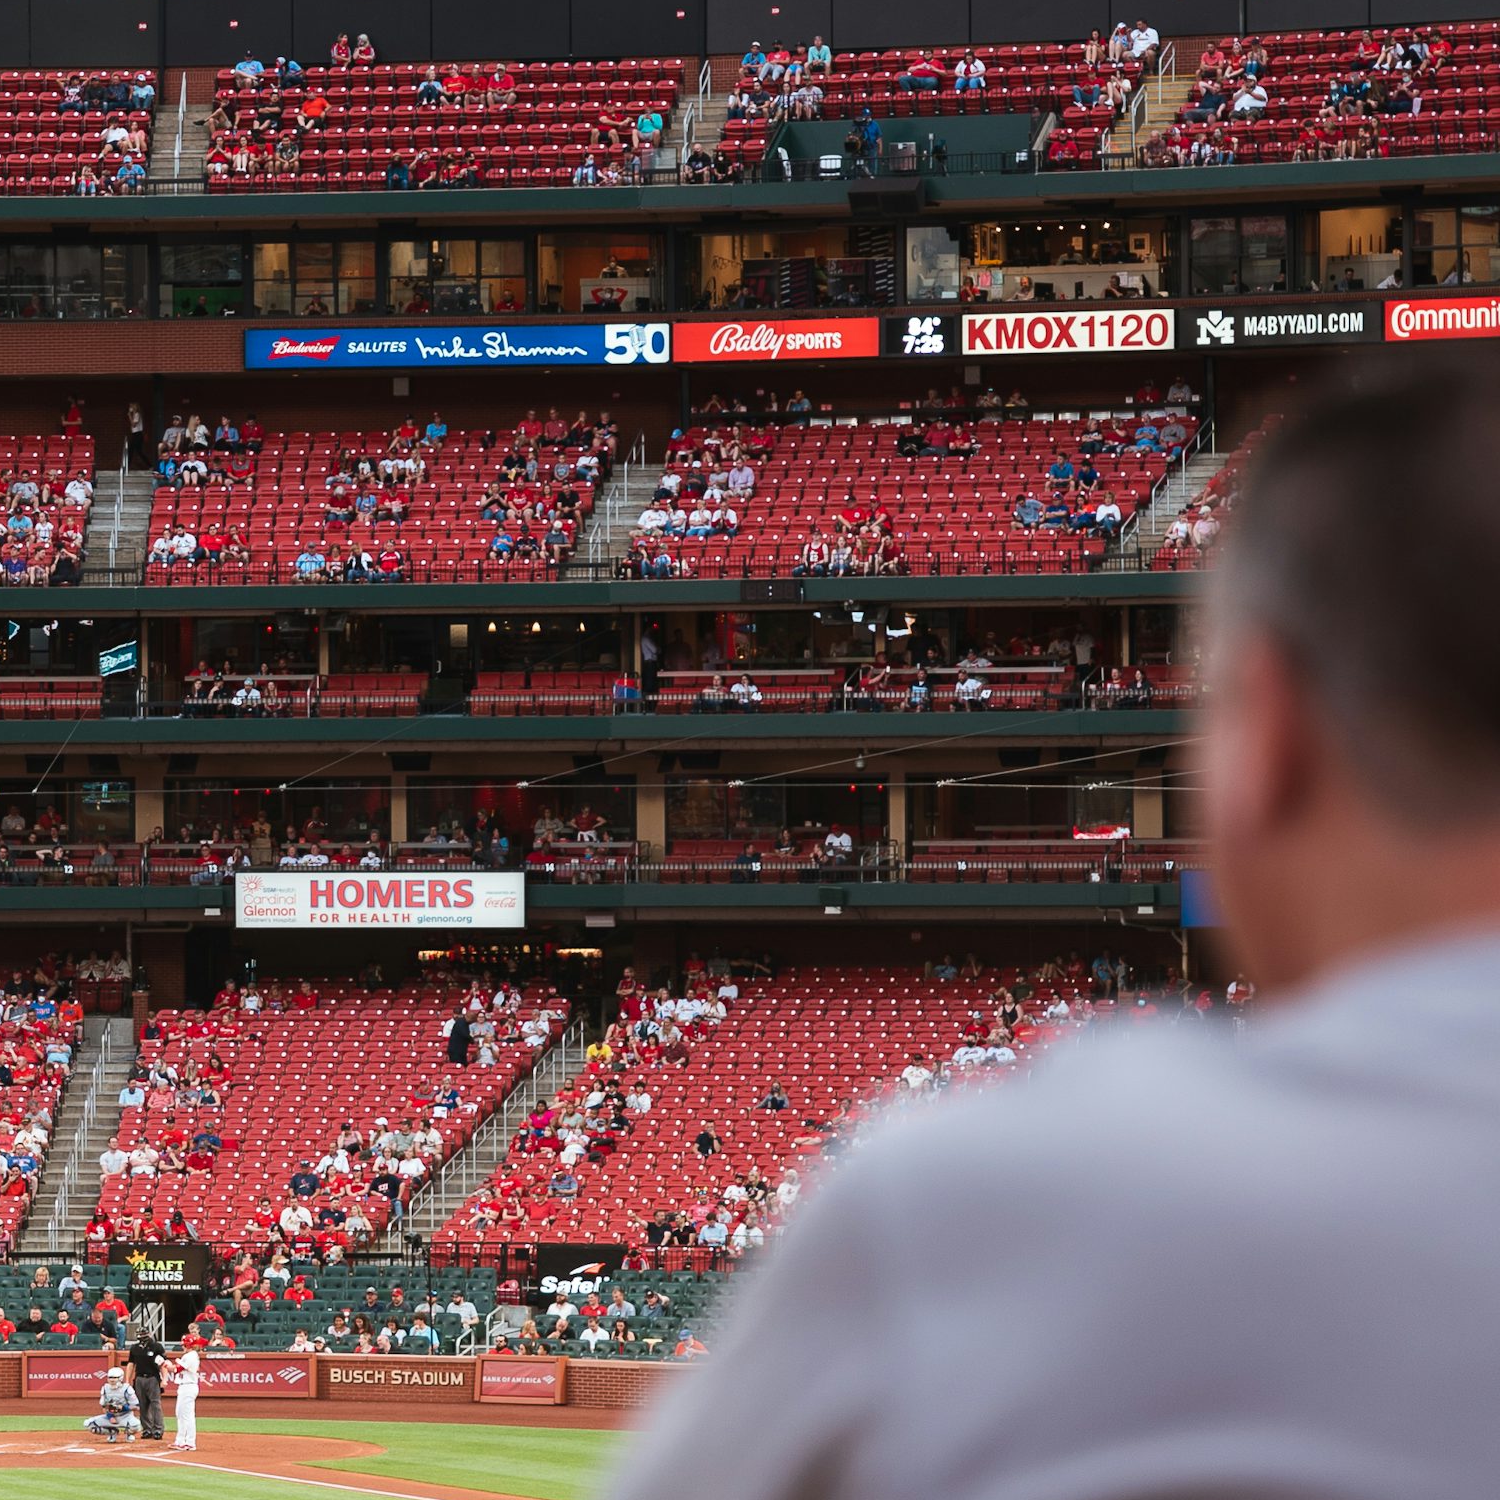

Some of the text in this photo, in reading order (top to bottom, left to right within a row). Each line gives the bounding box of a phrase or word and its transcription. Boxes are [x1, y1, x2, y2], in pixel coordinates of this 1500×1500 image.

[1244, 313, 1364, 337] M4BYYADI.COM
[272, 341, 334, 355] Budweiser
[347, 341, 407, 353] SALUTES
[482, 332, 588, 358] Shannon
[603, 323, 670, 364] 50
[709, 324, 842, 359] Bally SPORTS
[902, 334, 944, 354] 7:25
[231, 697, 242, 706] 45
[751, 692, 762, 701] 46
[64, 865, 73, 874] 12
[208, 864, 218, 873] 13
[545, 863, 555, 872] 14
[751, 862, 761, 871] 15
[957, 861, 967, 870] 16
[1165, 861, 1174, 870] 17
[310, 879, 474, 908] HOMERS
[243, 894, 297, 905] Cardinal
[243, 905, 296, 916] Glennon
[310, 913, 473, 924] FOR HEALTH glennon.org
[539, 1275, 612, 1293] Safel
[210, 1372, 274, 1384] AMERICA
[330, 1368, 464, 1386] BUSCH STADIUM
